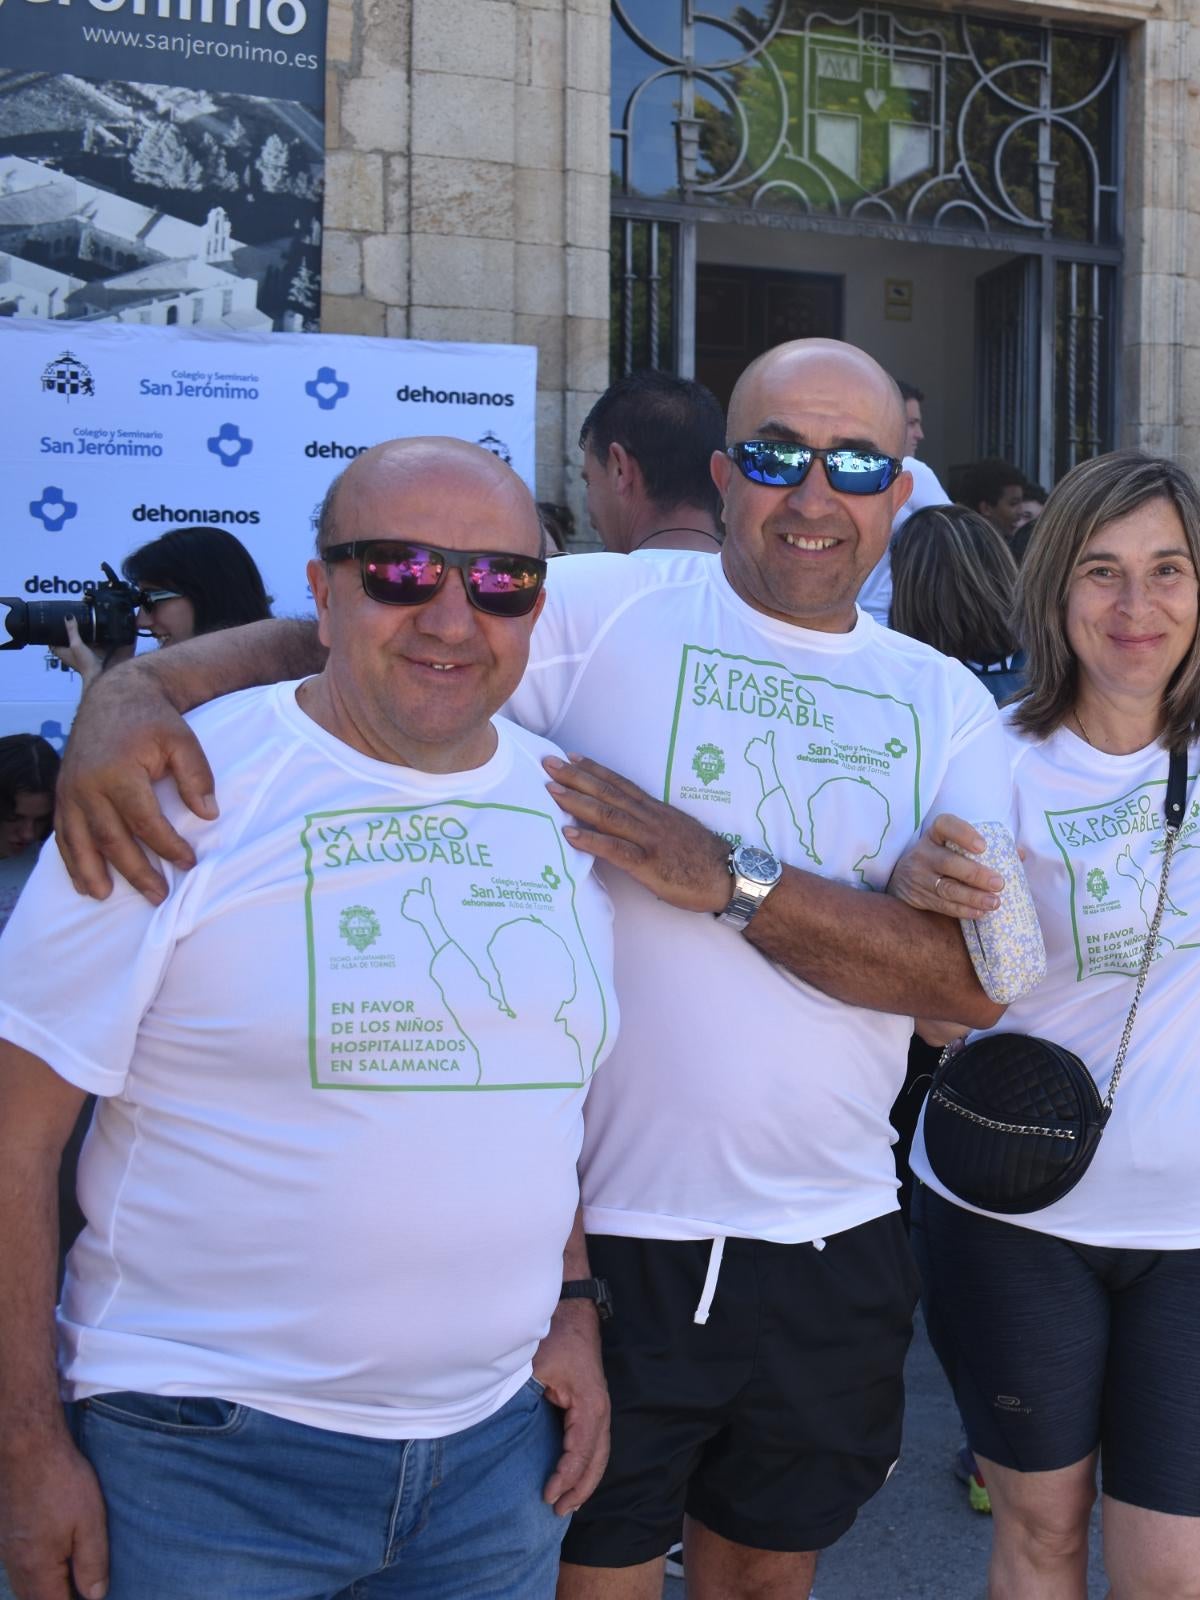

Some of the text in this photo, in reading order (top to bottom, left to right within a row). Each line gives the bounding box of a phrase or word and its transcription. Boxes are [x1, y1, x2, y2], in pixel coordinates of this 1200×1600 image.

[82, 25, 318, 70] www.sanjeronimo.es
[172, 370, 259, 384] Colegio y Seminario
[140, 379, 259, 400] San Jerónimo
[396, 385, 514, 406] dehonianos
[73, 427, 163, 440] Colegio y Seminario
[40, 437, 163, 457] San Jerónimo
[132, 504, 260, 524] dehonianos
[694, 662, 816, 706] IX PASEO
[692, 686, 834, 734] SALUDABLE
[808, 743, 890, 769] San Jerónimo
[1058, 795, 1151, 837] IX PASEO
[318, 814, 468, 843] IX PASEO
[1067, 812, 1162, 847] SALUDABLE
[325, 842, 493, 868] SALUDABLE
[470, 884, 553, 903] San Jerónimo
[1087, 928, 1134, 944] EN FAVOR
[1104, 942, 1121, 952] LOS
[1124, 933, 1147, 947] NIÑOS
[332, 1000, 414, 1014] EN FAVOR
[332, 1017, 444, 1034] DE LOS NIÑOS
[331, 1039, 466, 1054] HOSPITALIZADOS
[331, 1058, 460, 1072] EN SALAMANCA
